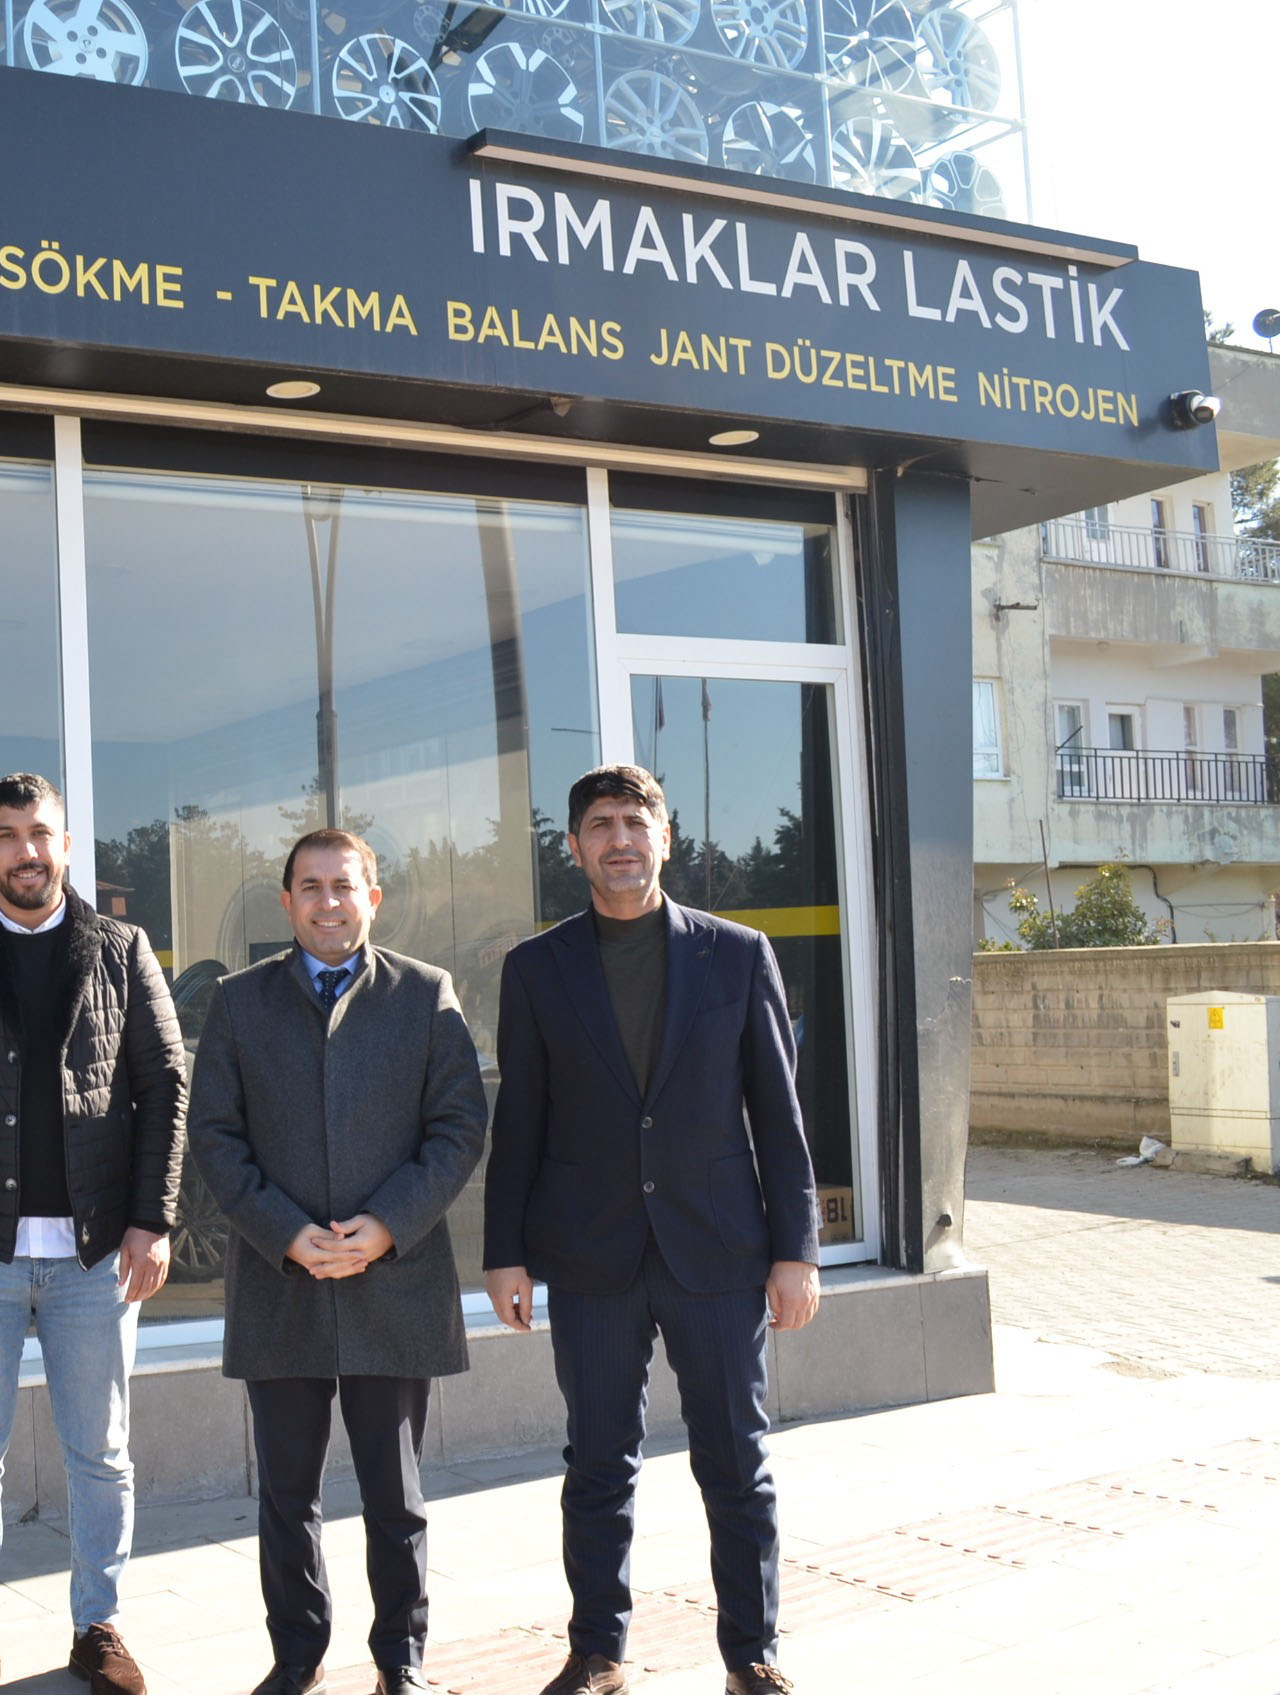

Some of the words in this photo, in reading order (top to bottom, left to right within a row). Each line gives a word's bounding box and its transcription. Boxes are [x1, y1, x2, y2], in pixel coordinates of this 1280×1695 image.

[469, 178, 881, 312] IRMAKLAR
[903, 250, 1131, 351] LASTİK
[248, 275, 418, 336] TAKMA
[447, 300, 625, 361] BALANS
[649, 327, 753, 376] JANT
[764, 338, 958, 403] DÜZELTME
[977, 367, 1139, 427] NİTROJEN
